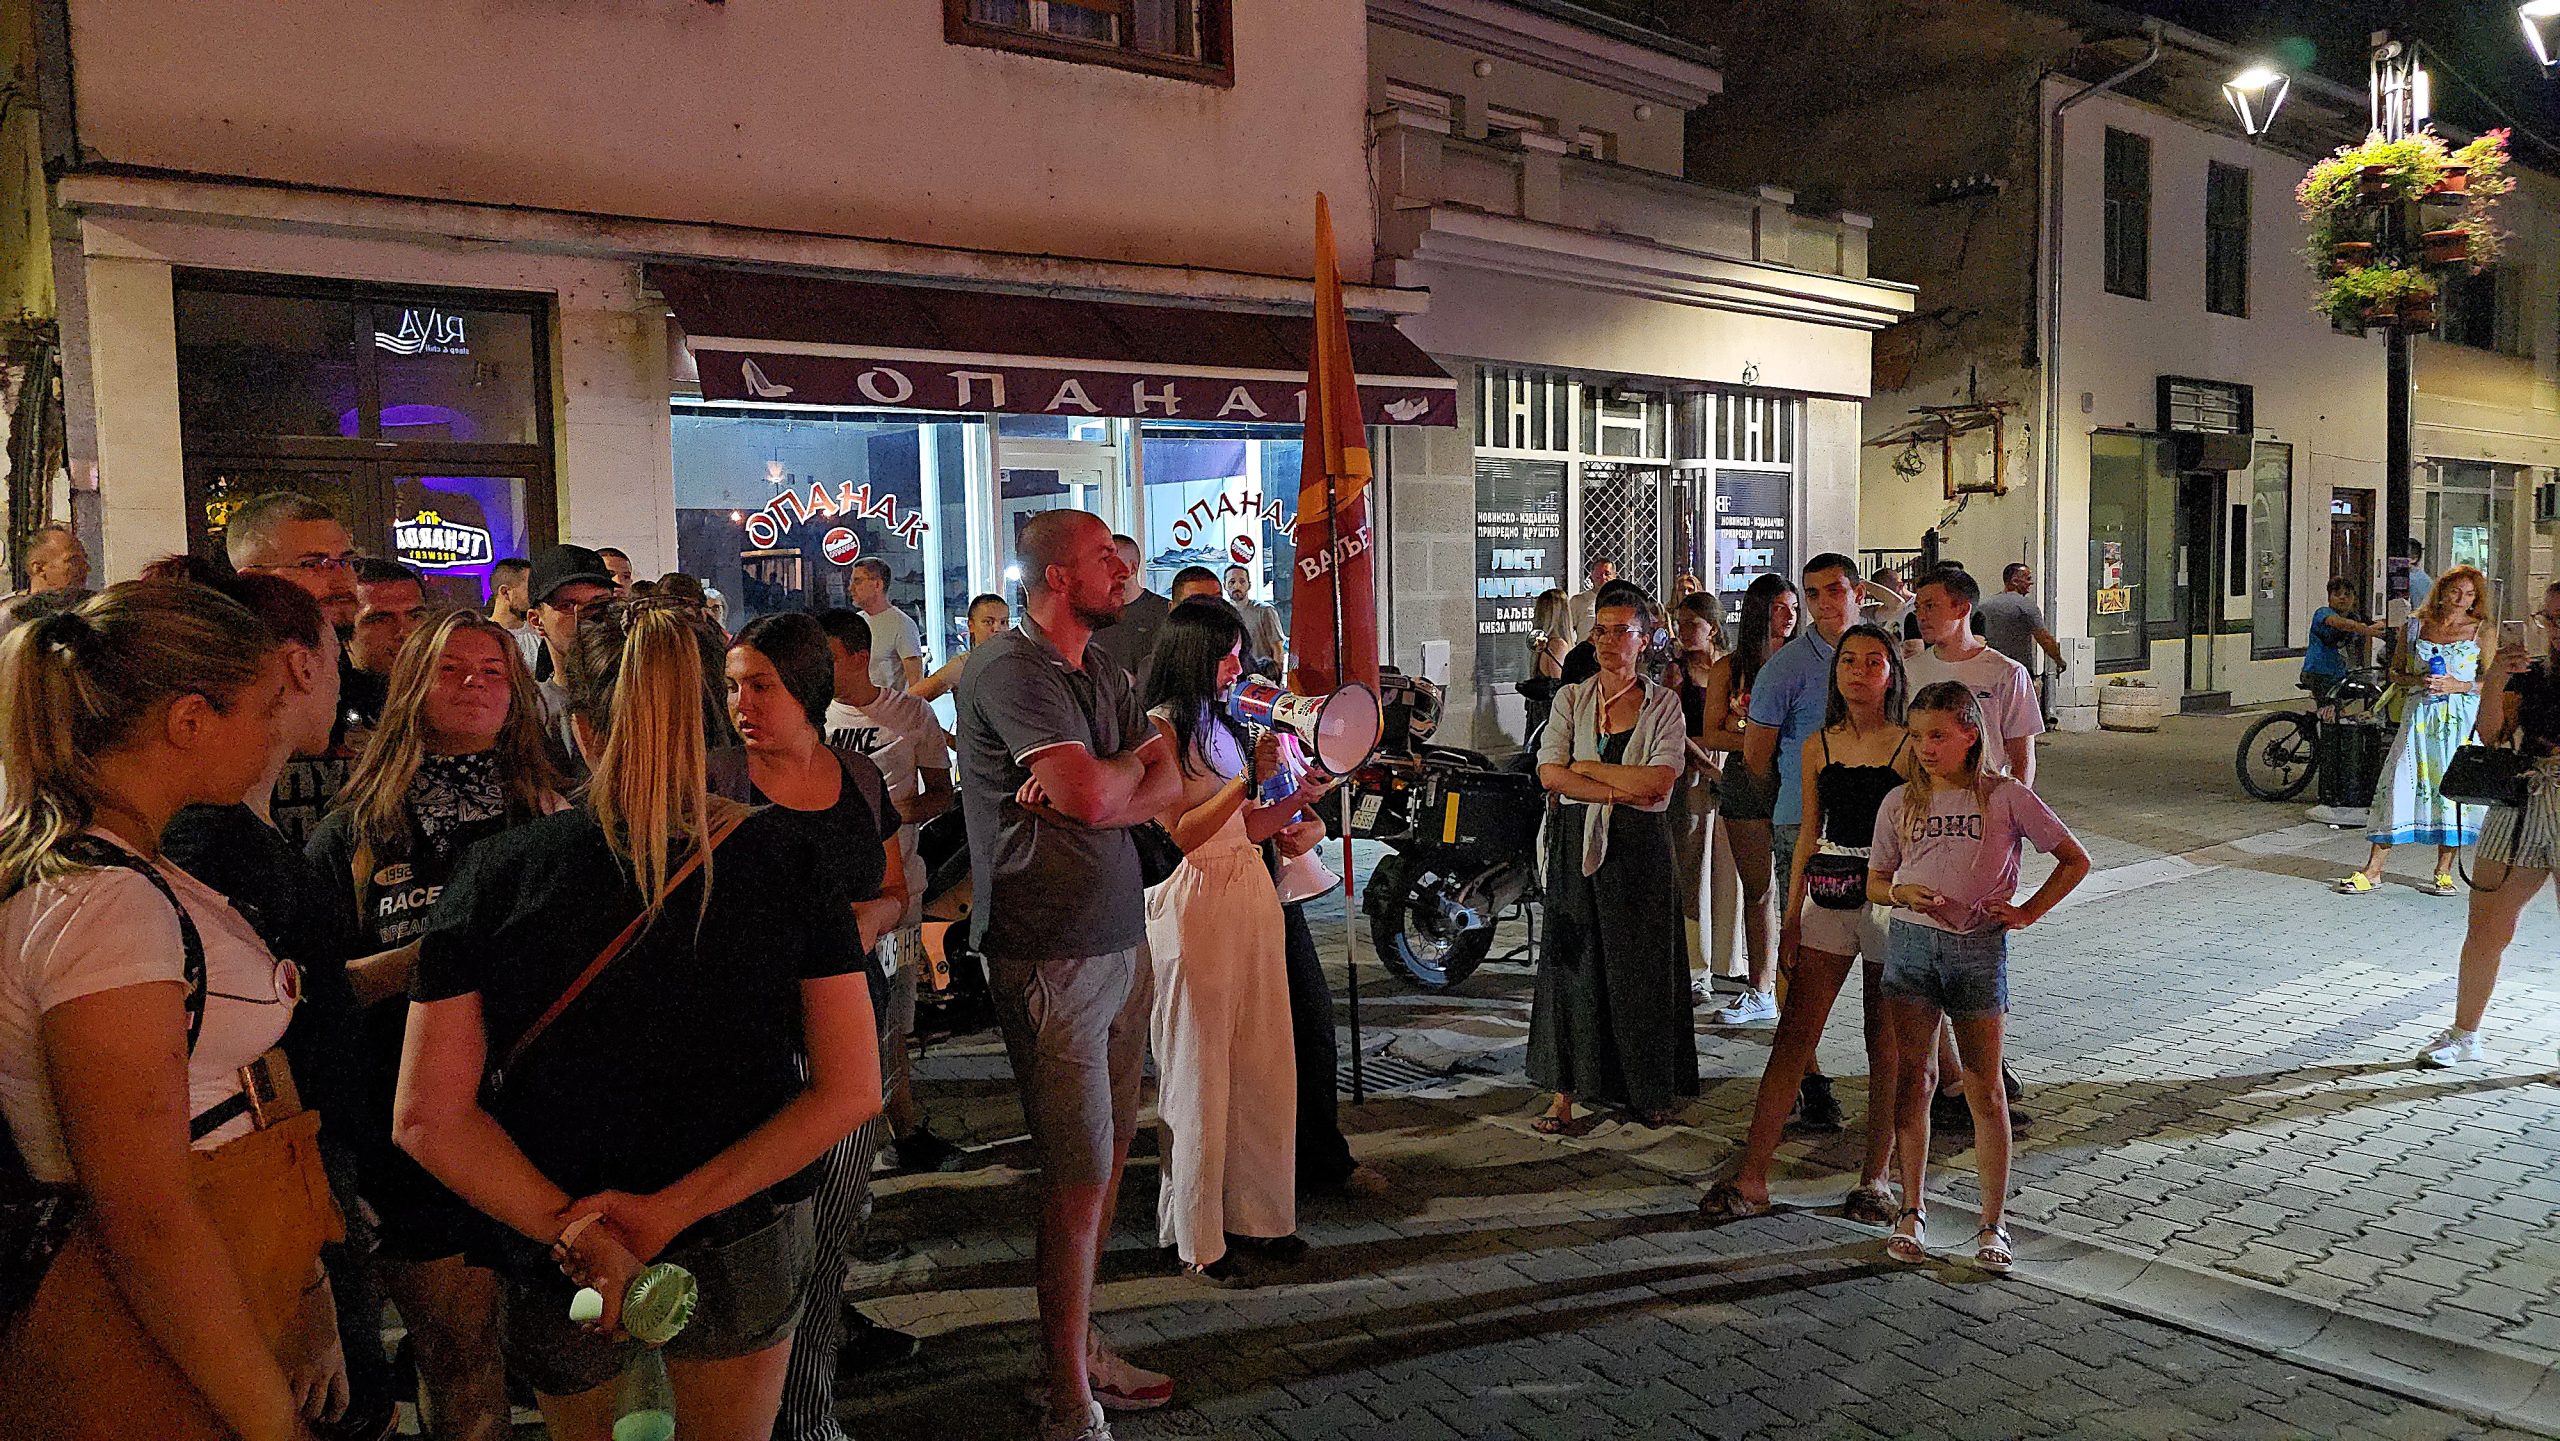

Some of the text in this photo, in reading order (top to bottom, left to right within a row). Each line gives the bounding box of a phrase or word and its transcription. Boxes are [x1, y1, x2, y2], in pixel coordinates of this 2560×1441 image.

[857, 366, 1307, 422] ОПАНА
[745, 480, 930, 549] ОПАНАК
[1477, 526, 1560, 540] ПРИВРЕДНО ДРУШТВО
[1491, 548, 1546, 570] ЛИСТ
[1732, 548, 1774, 567] ЛИСТ
[1479, 621, 1506, 634] КНЕЗА
[830, 726, 880, 752] NIKE
[379, 885, 444, 917] RACE
